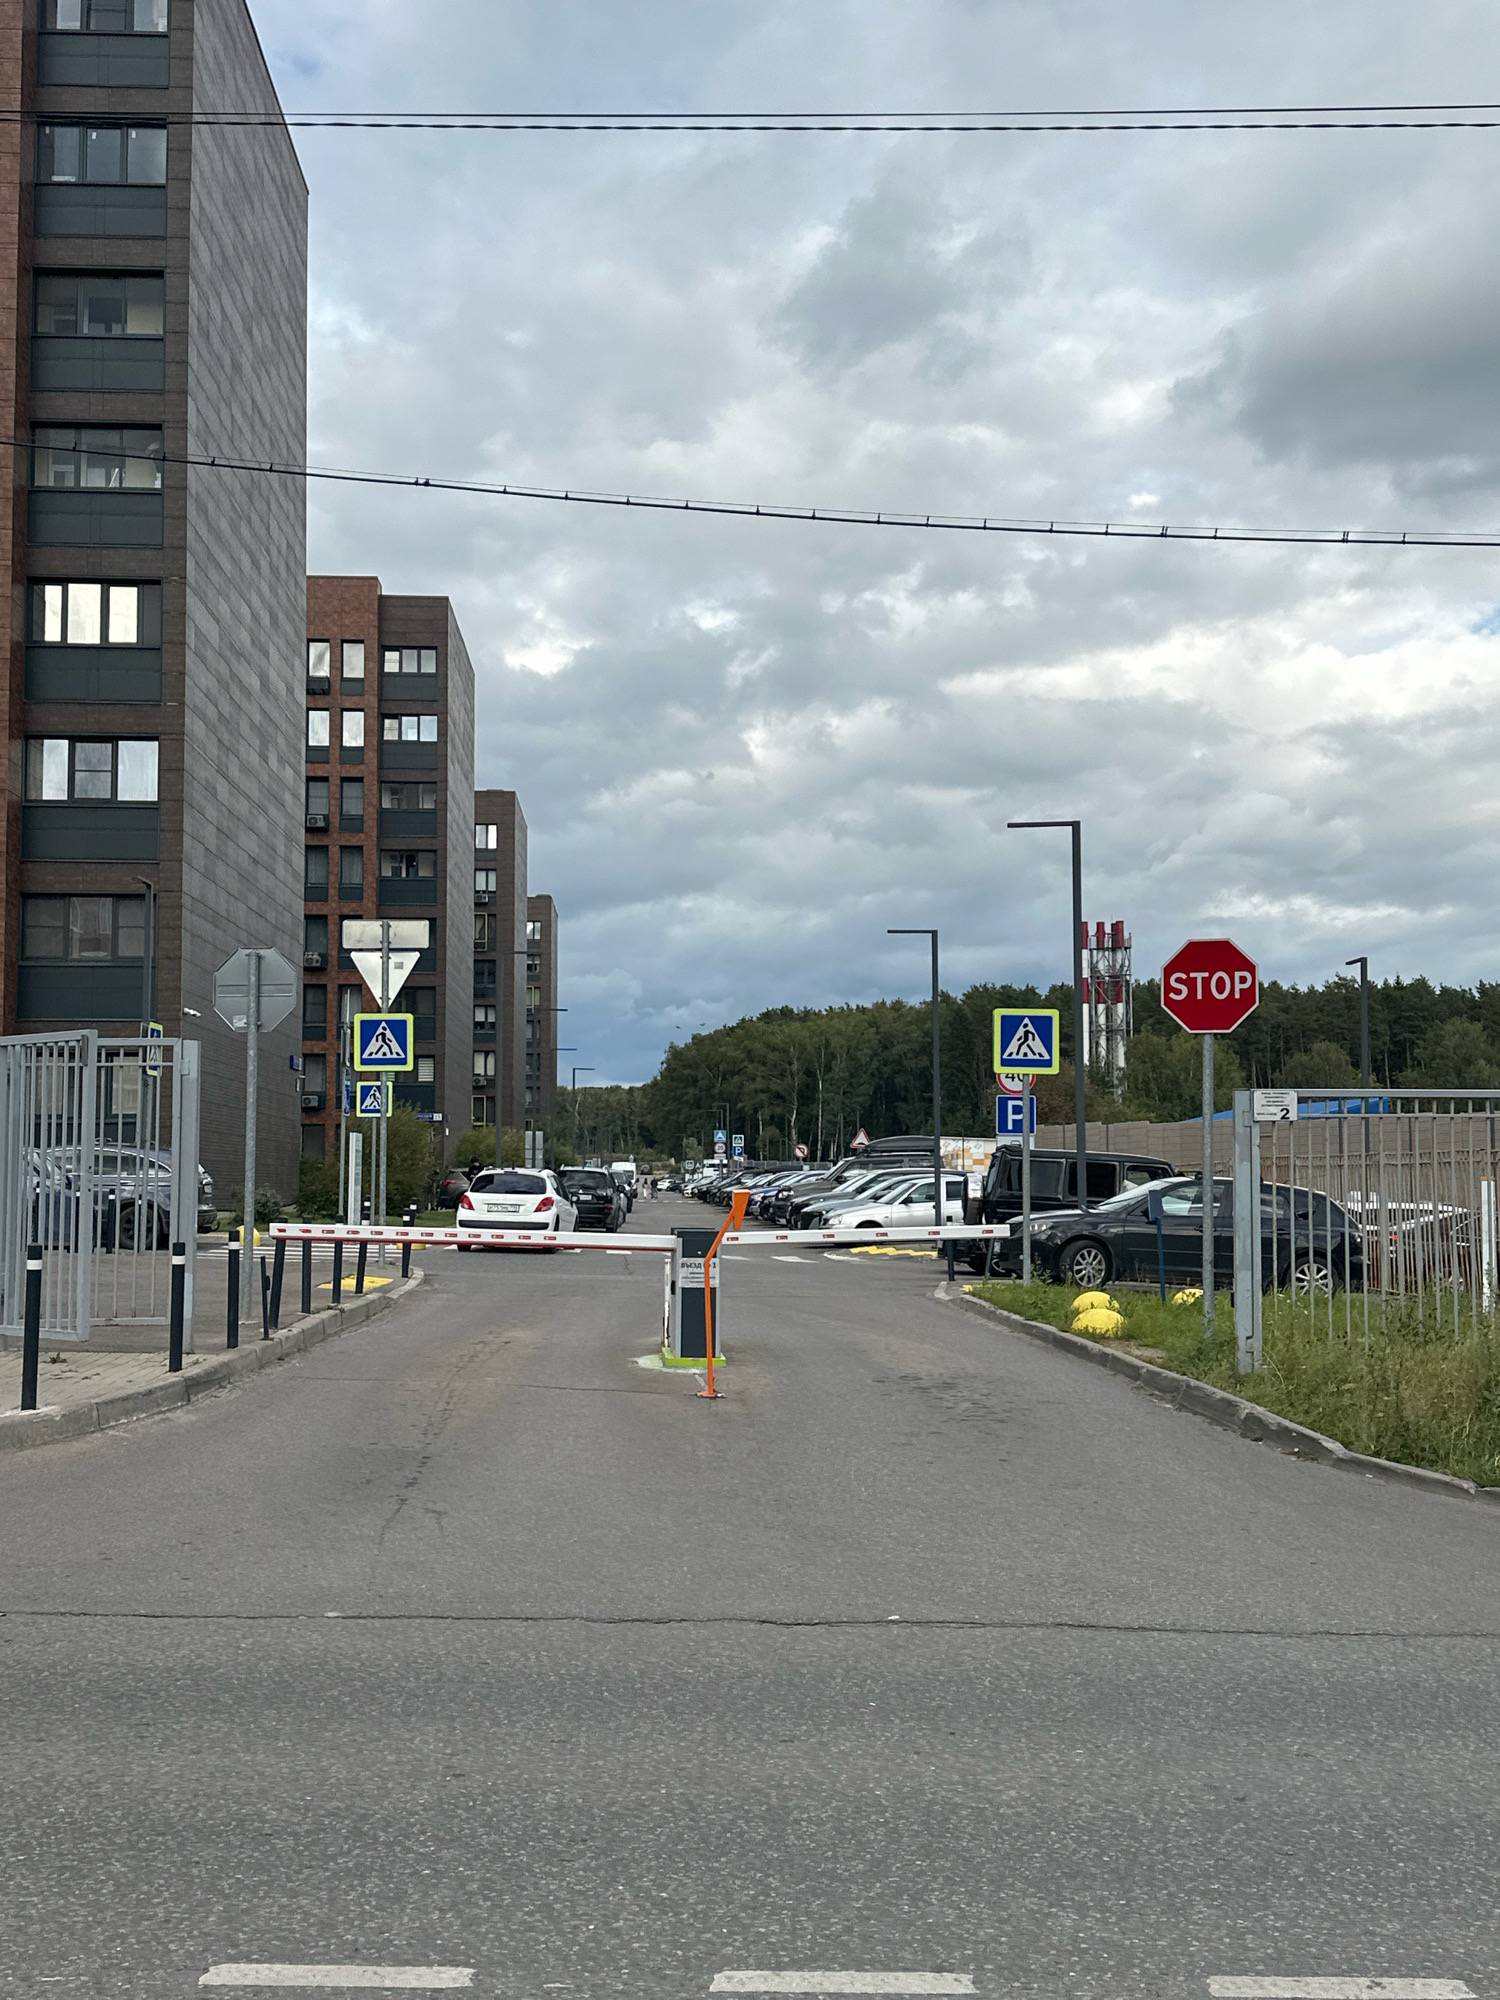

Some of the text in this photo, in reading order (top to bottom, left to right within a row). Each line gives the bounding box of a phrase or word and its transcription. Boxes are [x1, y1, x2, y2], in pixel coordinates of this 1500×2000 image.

[1168, 970, 1253, 1001] STOP
[1007, 1100, 1023, 1130] P
[1280, 1108, 1290, 1120] 2
[735, 1147, 742, 1155] P
